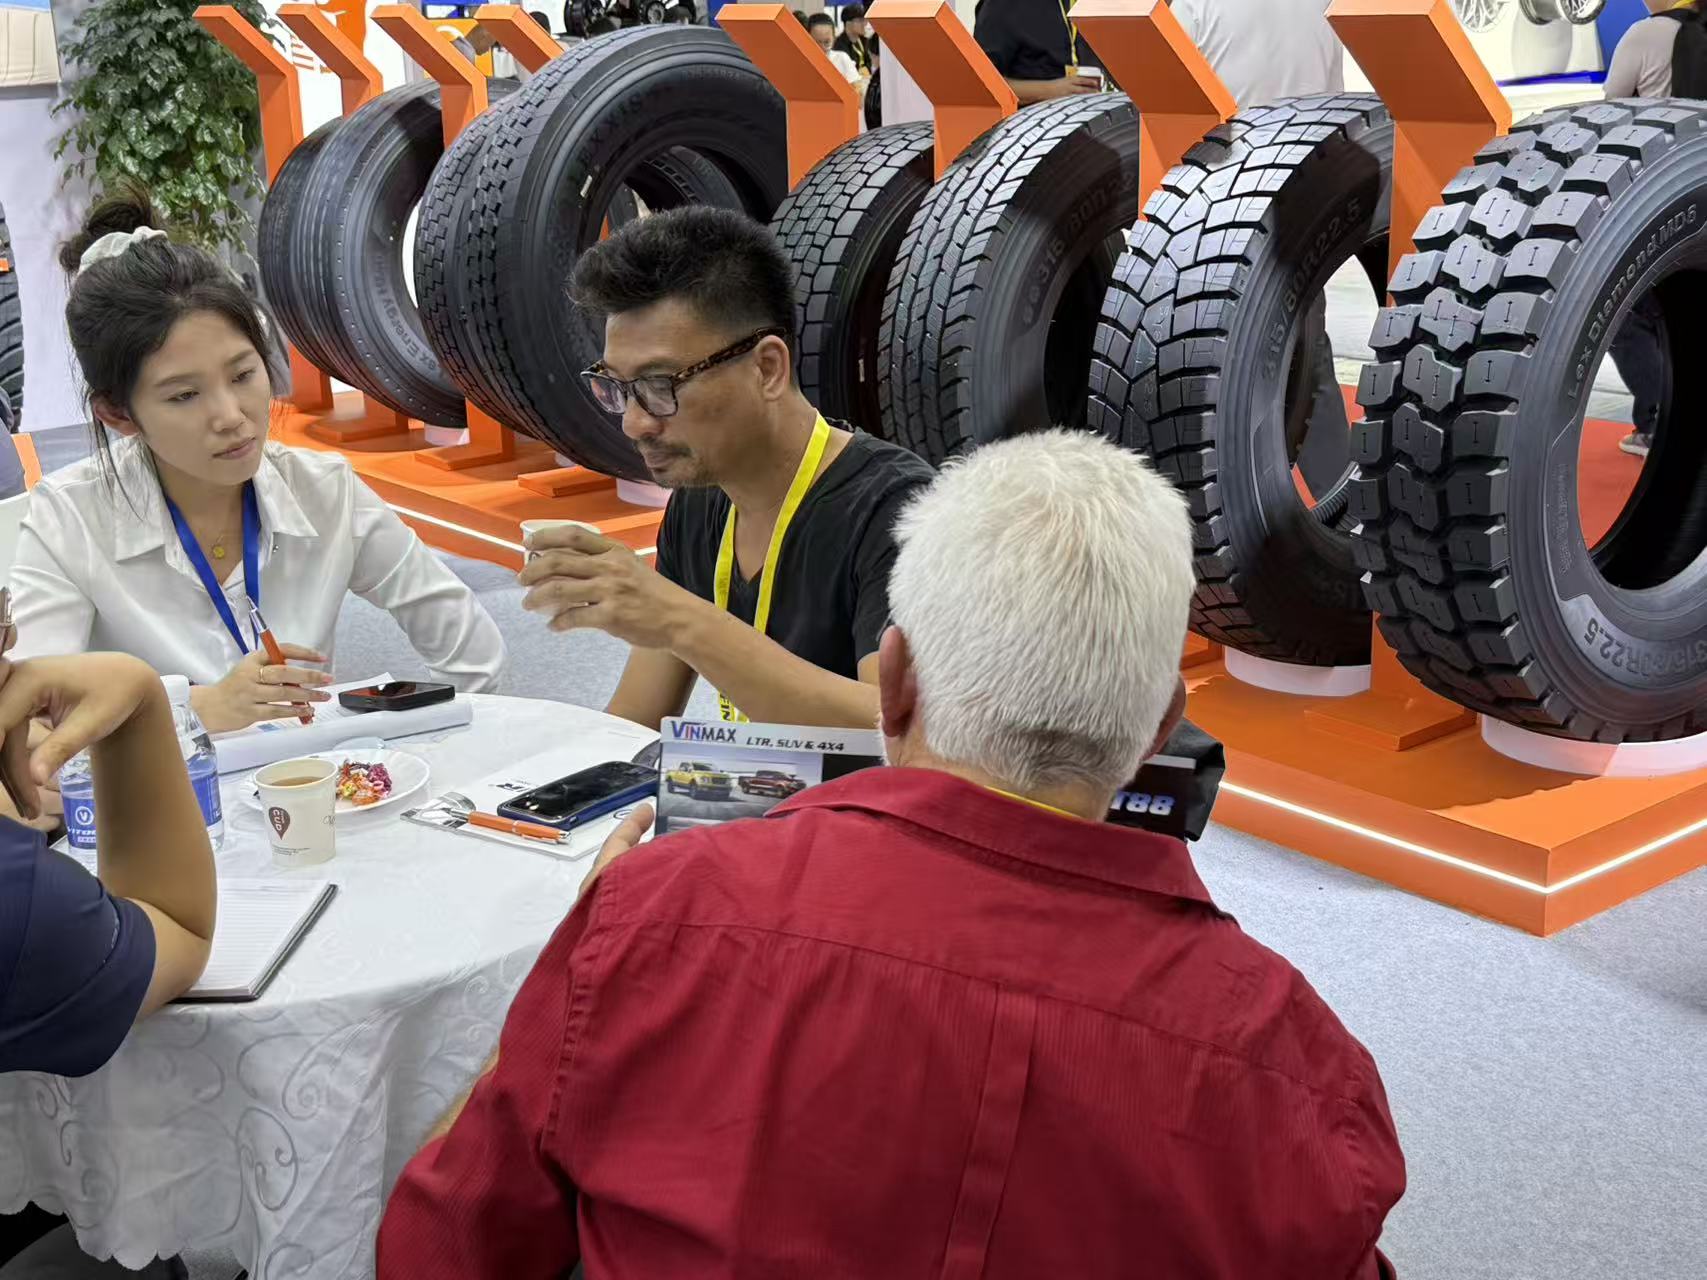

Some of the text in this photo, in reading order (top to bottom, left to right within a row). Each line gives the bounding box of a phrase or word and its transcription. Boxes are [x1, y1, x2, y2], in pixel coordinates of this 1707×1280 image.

[1567, 203, 1698, 399] Lex Diamond MD6
[382, 298, 420, 359] Energy
[776, 739, 804, 749] SUV
[804, 740, 814, 750] &
[272, 809, 283, 831] CUP
